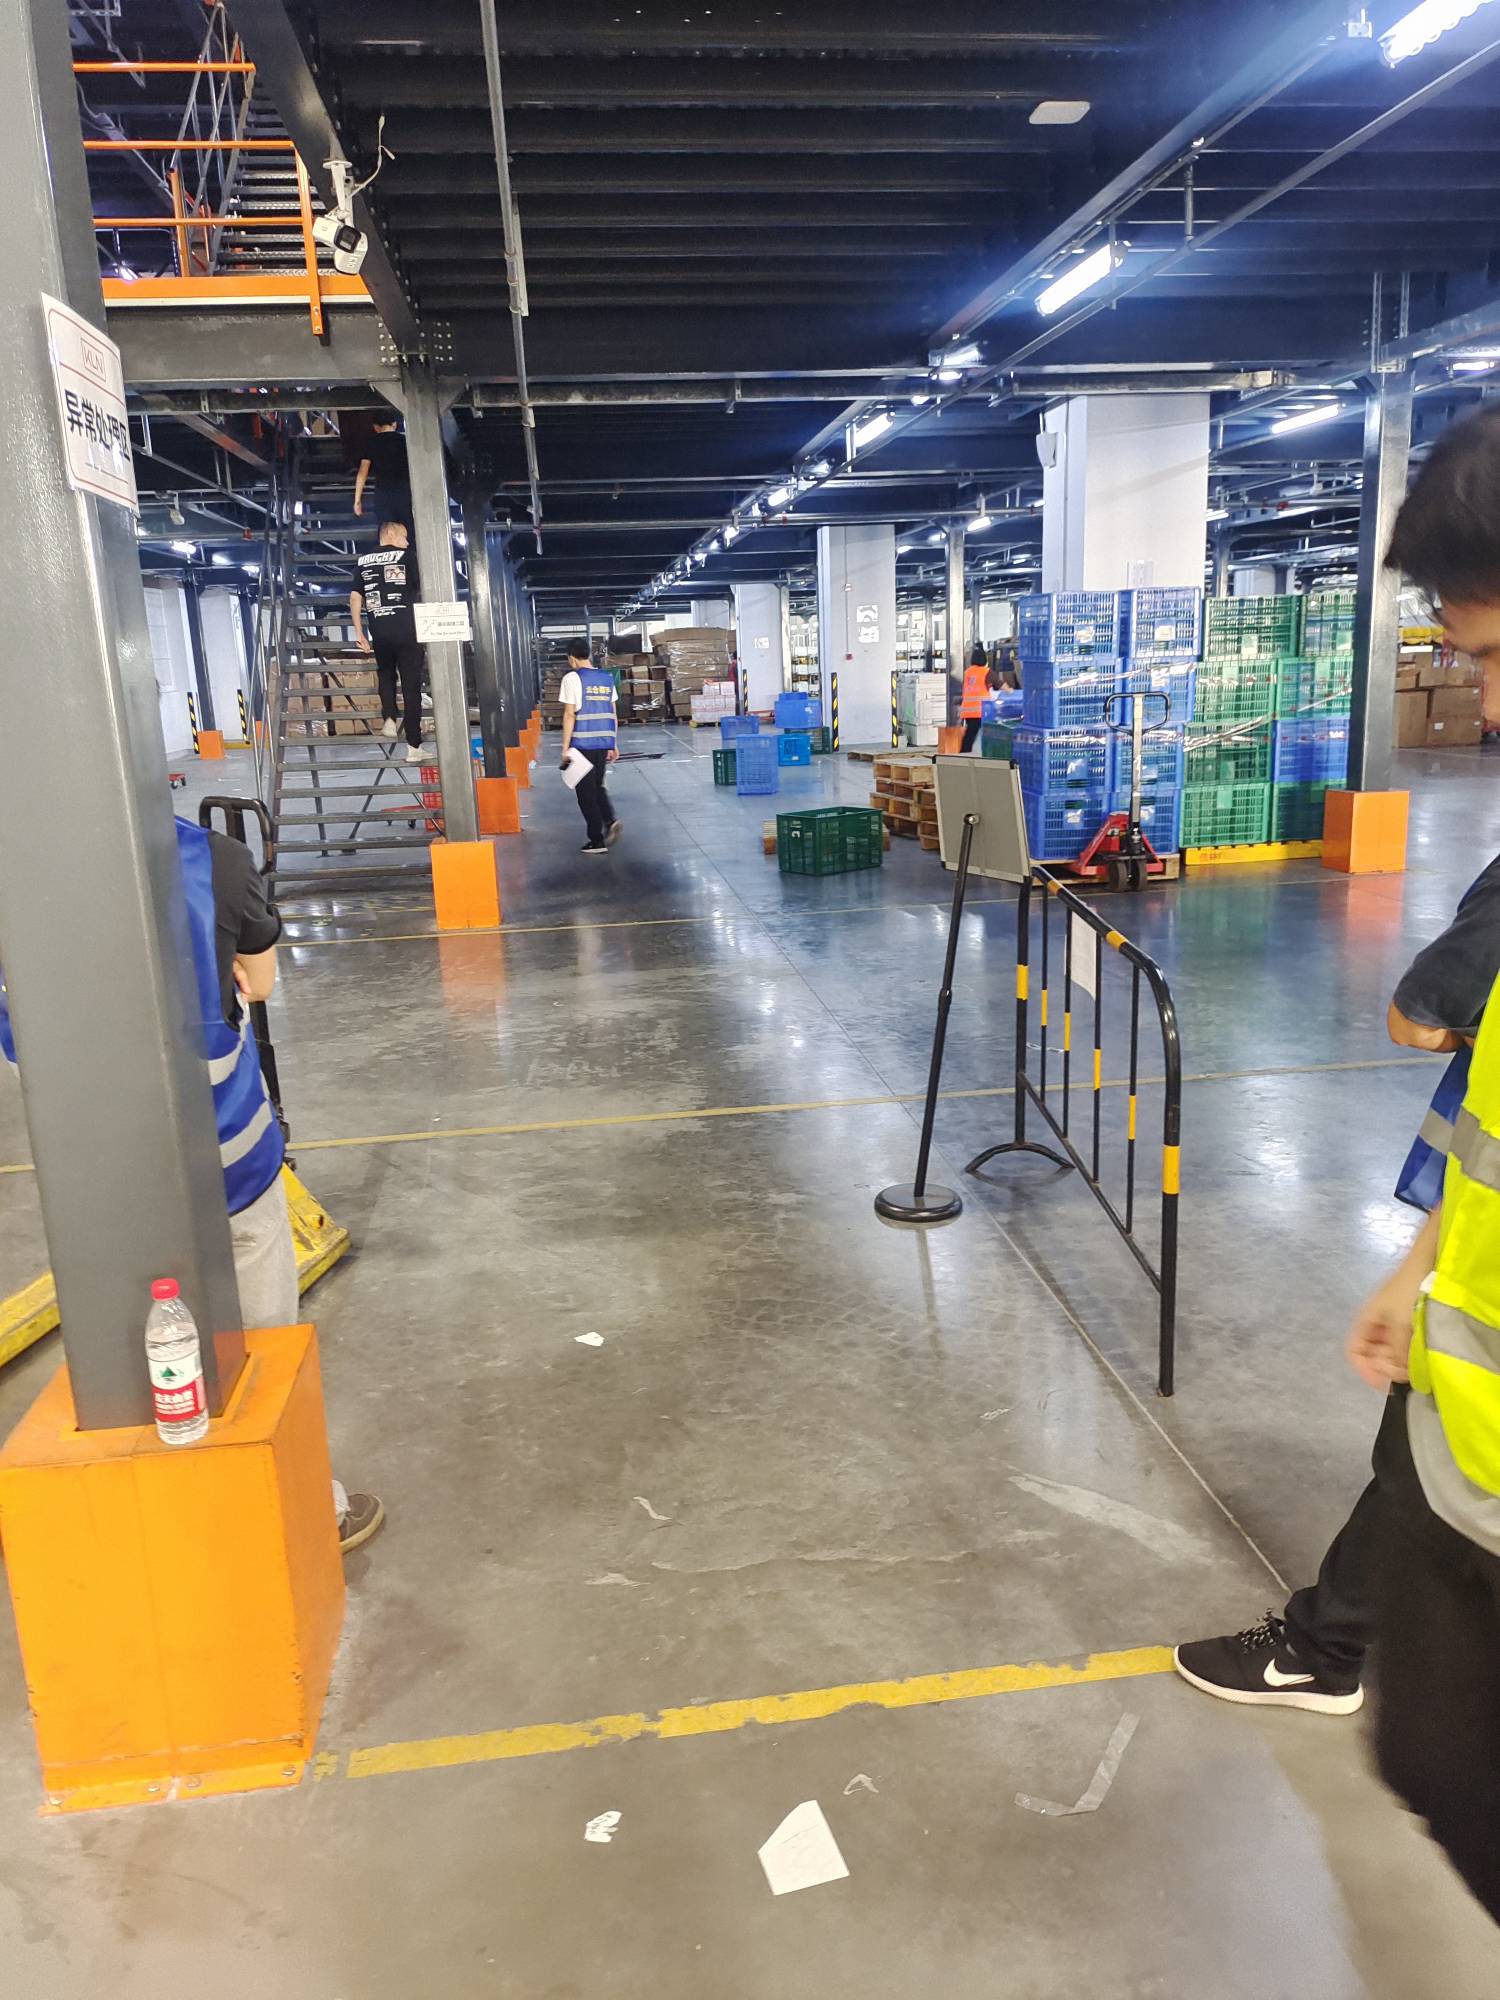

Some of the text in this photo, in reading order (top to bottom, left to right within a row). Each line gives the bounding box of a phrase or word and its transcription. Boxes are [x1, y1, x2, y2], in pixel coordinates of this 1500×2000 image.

[65, 389, 131, 462] 异常处理区
